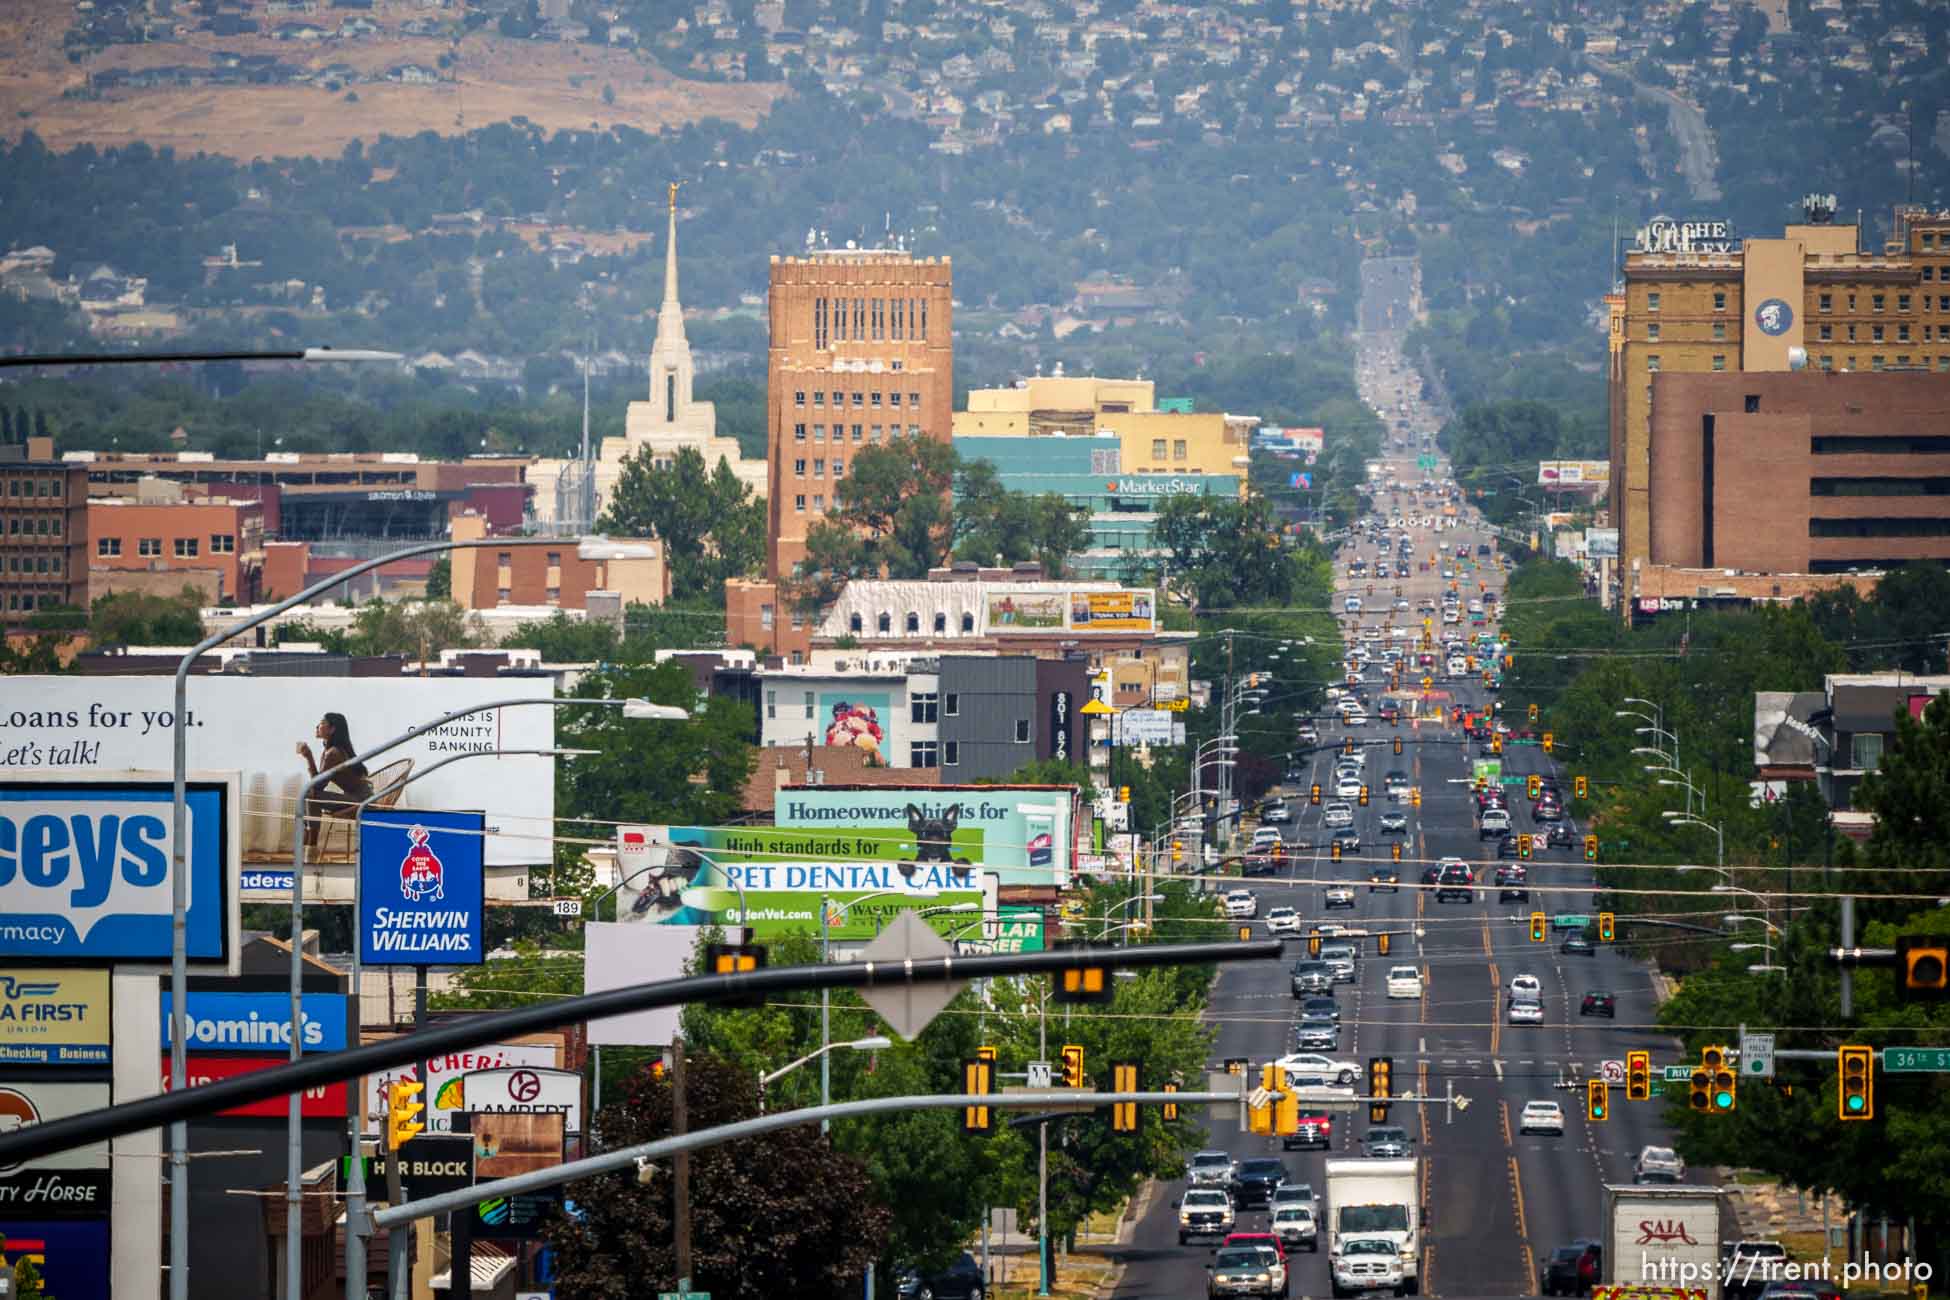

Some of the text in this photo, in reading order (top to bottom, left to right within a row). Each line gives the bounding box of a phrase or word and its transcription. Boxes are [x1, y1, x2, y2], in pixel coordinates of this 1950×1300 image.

[1119, 479, 1201, 494] MarketStar
[88, 702, 131, 729] for
[444, 711, 493, 722] IS IS
[408, 726, 492, 737] CMMUNITY
[49, 740, 101, 765] talk!
[429, 741, 494, 752] BANKING
[980, 801, 1008, 820] for
[727, 838, 880, 859] High standards for
[726, 865, 977, 890] PET DENTAL CARE
[556, 902, 579, 914] 189
[373, 906, 469, 929] SHERWIN
[21, 1003, 89, 1021] FIRST
[7, 1025, 48, 1033] UNION
[168, 1011, 323, 1045] Domino's
[60, 1048, 107, 1060] Business
[413, 1161, 467, 1176] BLOCK
